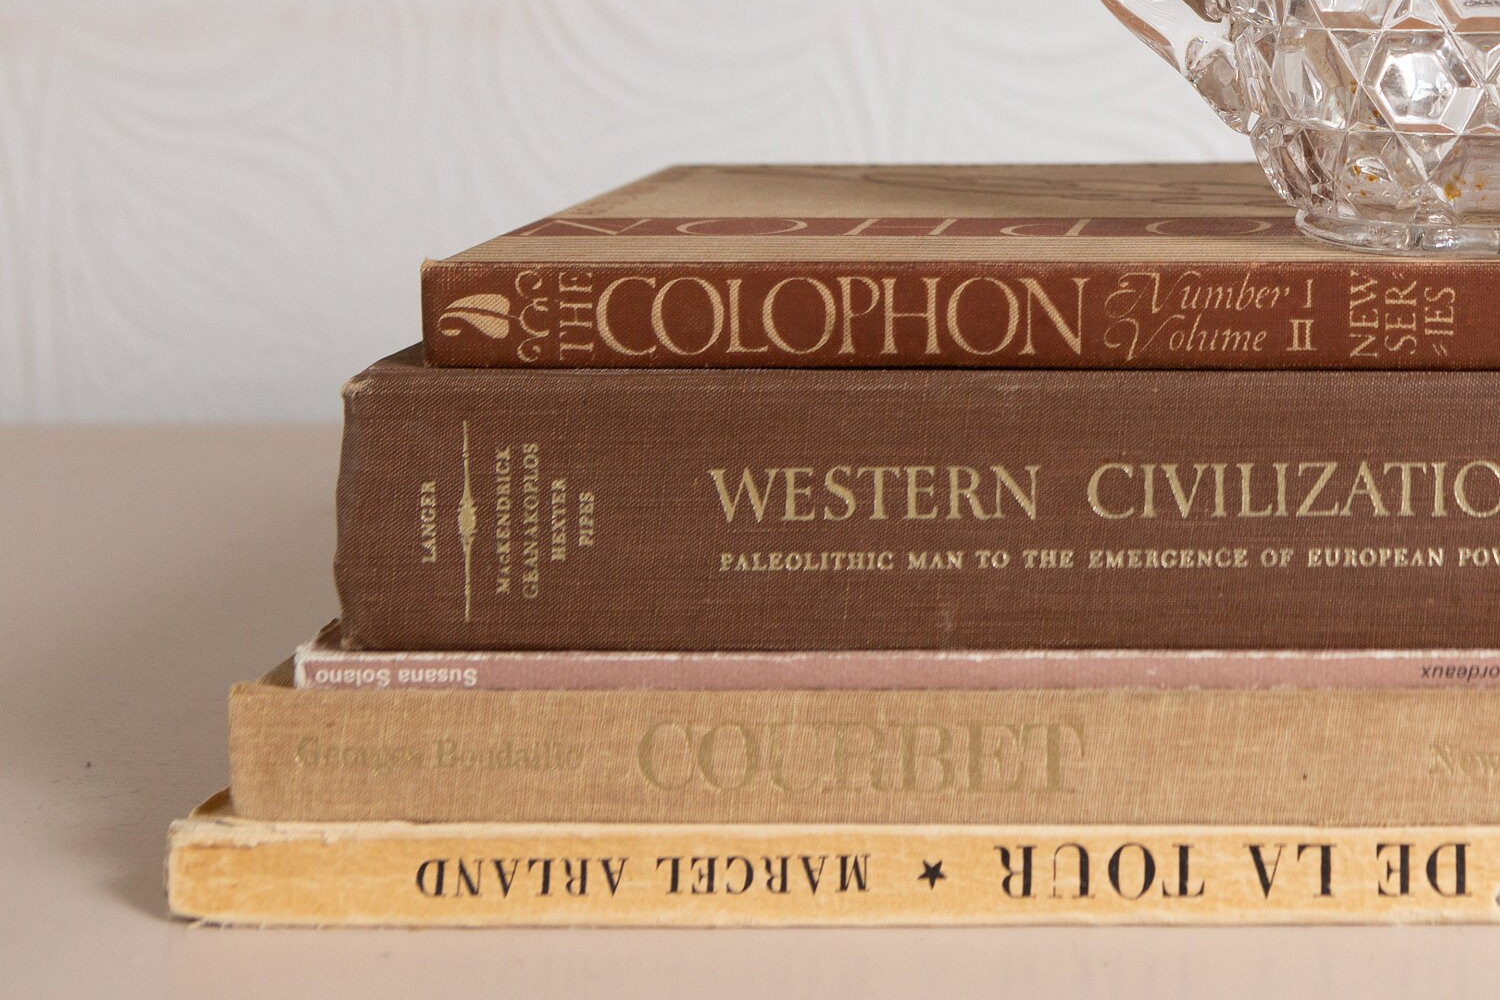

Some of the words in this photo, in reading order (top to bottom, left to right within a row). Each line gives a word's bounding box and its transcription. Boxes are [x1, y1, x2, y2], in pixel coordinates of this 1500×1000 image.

[558, 270, 594, 362] THE
[595, 275, 1088, 357] COLOPHON
[1104, 270, 1290, 318] Number
[1303, 278, 1314, 309] I
[1349, 268, 1379, 358] NEW
[1104, 314, 1267, 362] Volume
[1286, 318, 1317, 351] II
[420, 479, 437, 564] LANGER
[522, 442, 540, 600] GEANAKOPLOS
[550, 477, 567, 563] HEXTER
[577, 491, 595, 547] PIPES
[709, 464, 1042, 523] WESTERN
[719, 551, 894, 572] PALEOLITHIC
[907, 550, 964, 571] MAN
[976, 549, 1010, 570] TO
[1023, 549, 1074, 570] THE
[1088, 547, 1249, 569] EMERGENCE
[1261, 547, 1294, 568] OF
[1307, 547, 1445, 569] EUROPEAN
[315, 668, 391, 688] Solano
[398, 667, 478, 688] Susana
[636, 720, 1088, 793] COURBET
[415, 857, 629, 898] ARLAND
[656, 854, 872, 895] MARCEL
[993, 841, 1205, 900] TOUR
[1242, 842, 1338, 900] LA
[1375, 842, 1473, 898] DE
